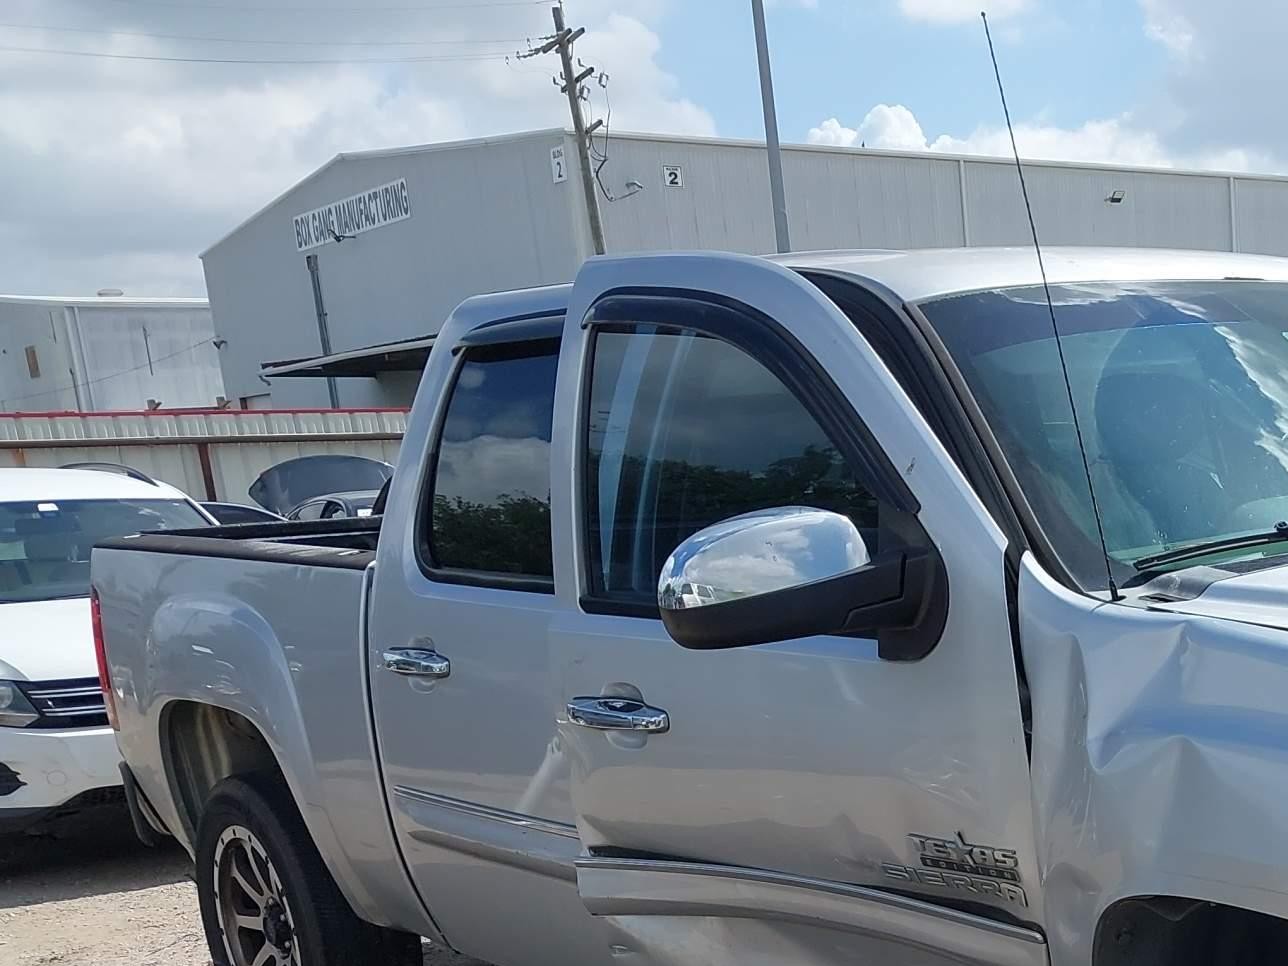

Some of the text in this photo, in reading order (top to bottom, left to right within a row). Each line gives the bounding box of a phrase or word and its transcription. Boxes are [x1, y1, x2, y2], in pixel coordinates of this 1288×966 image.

[556, 162, 563, 179] 2
[668, 171, 679, 185] 2
[295, 182, 409, 248] BOX GANG MANUFACTURING
[904, 831, 1019, 868] TEXAS
[922, 857, 1020, 881] EDITION
[880, 862, 1029, 908] SIERRA
